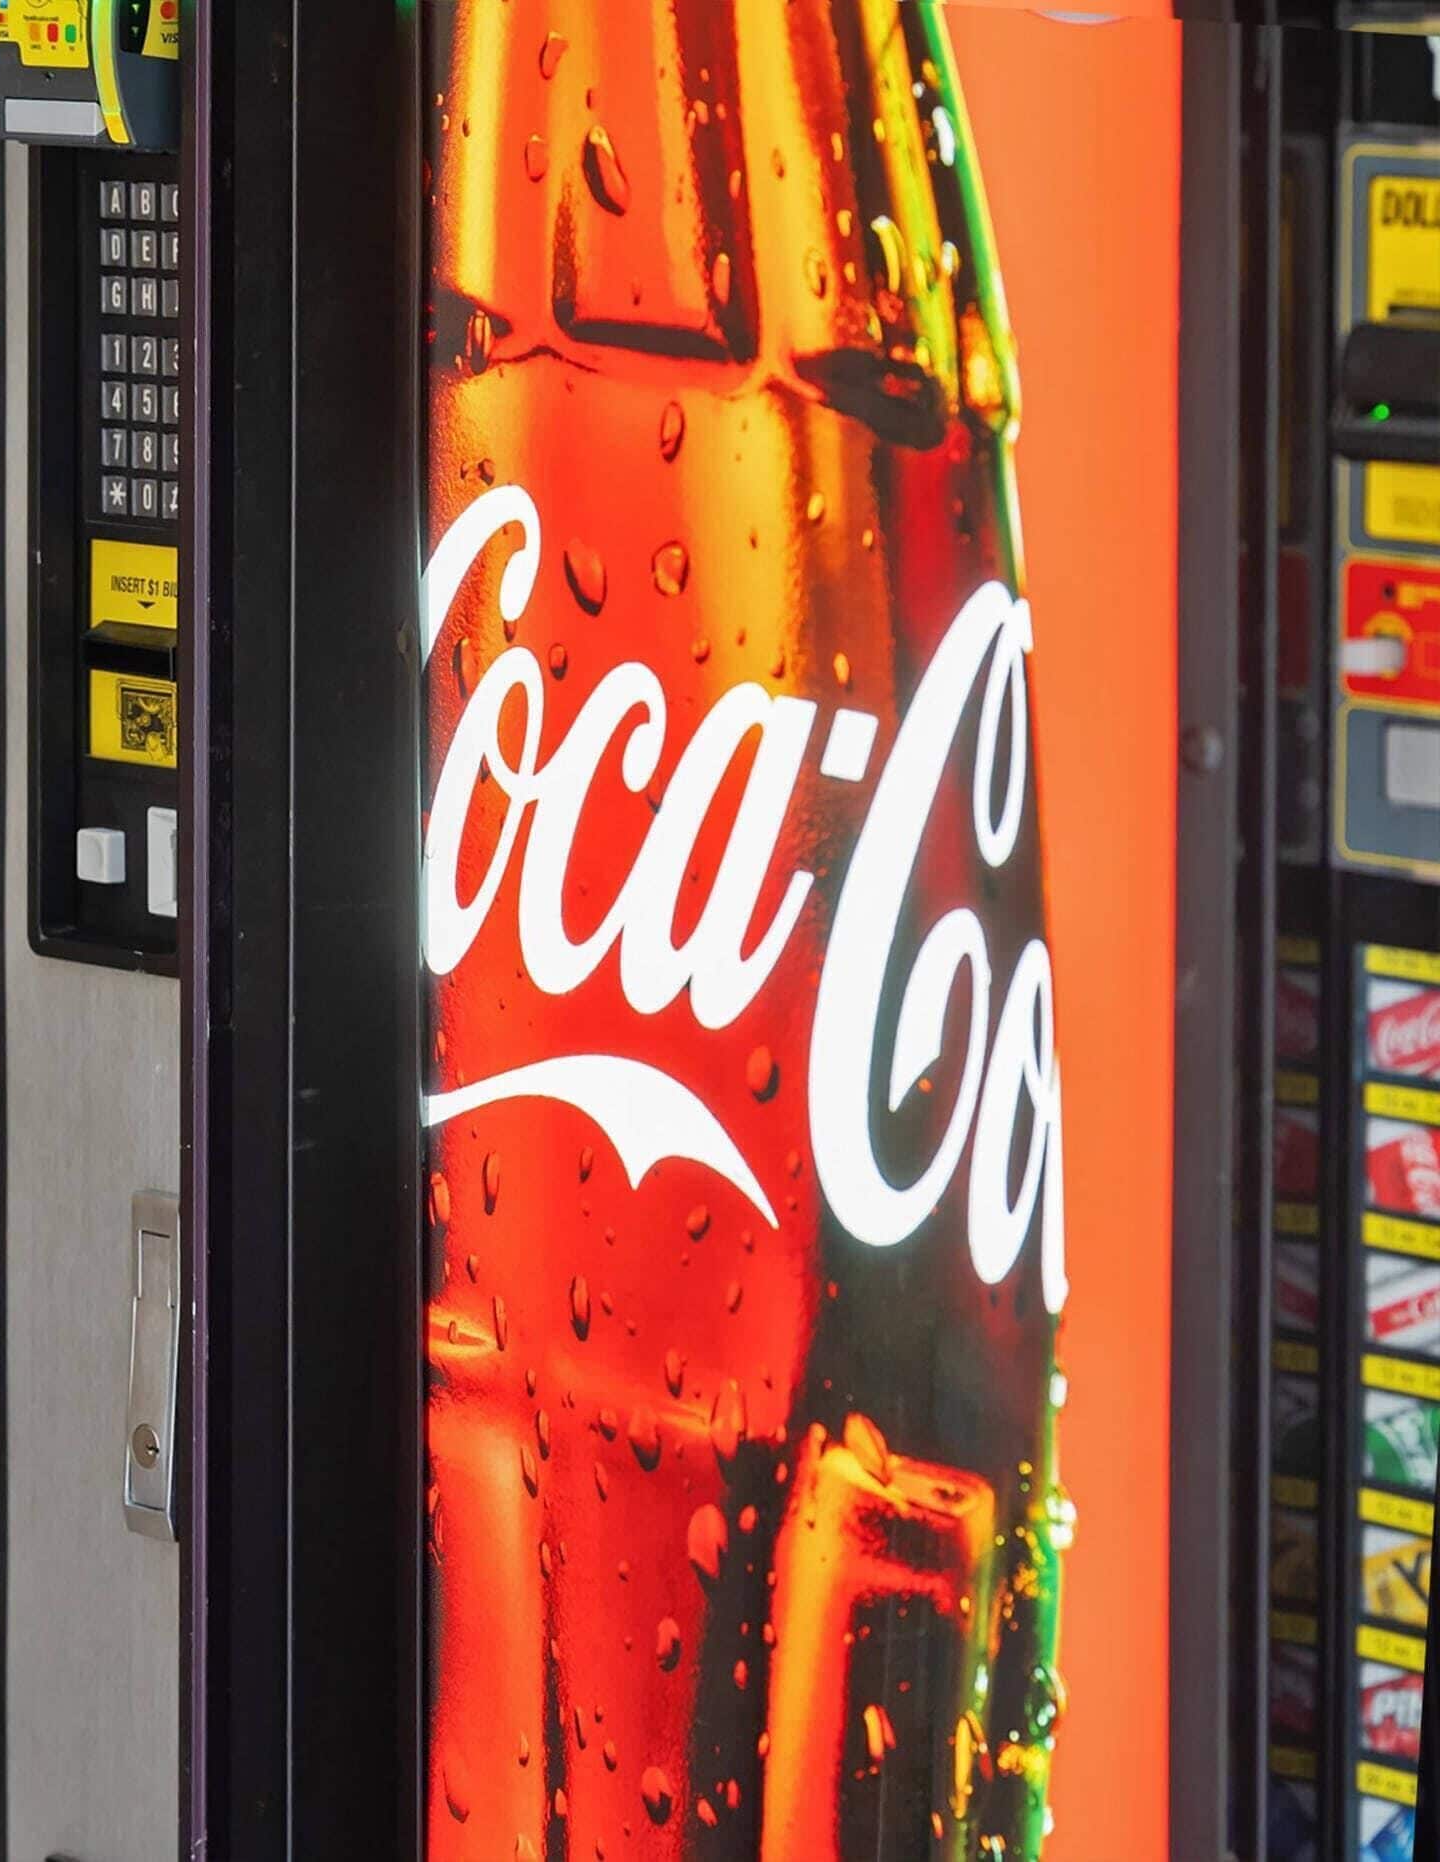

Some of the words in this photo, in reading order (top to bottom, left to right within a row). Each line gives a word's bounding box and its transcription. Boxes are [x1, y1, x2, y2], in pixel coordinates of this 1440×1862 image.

[162, 32, 179, 44] VIS
[111, 187, 121, 214] A
[141, 188, 151, 215] B
[111, 234, 121, 260] D
[142, 235, 151, 262] E
[111, 281, 121, 307] G
[142, 283, 152, 310] H
[113, 339, 120, 366] 1
[142, 341, 152, 369] 2
[111, 387, 121, 414] 4
[142, 388, 152, 416] 5
[112, 434, 122, 460] 7
[143, 436, 152, 463] 8
[111, 575, 146, 595] INSERT
[148, 578, 160, 597] $1
[163, 580, 179, 598] BIL
